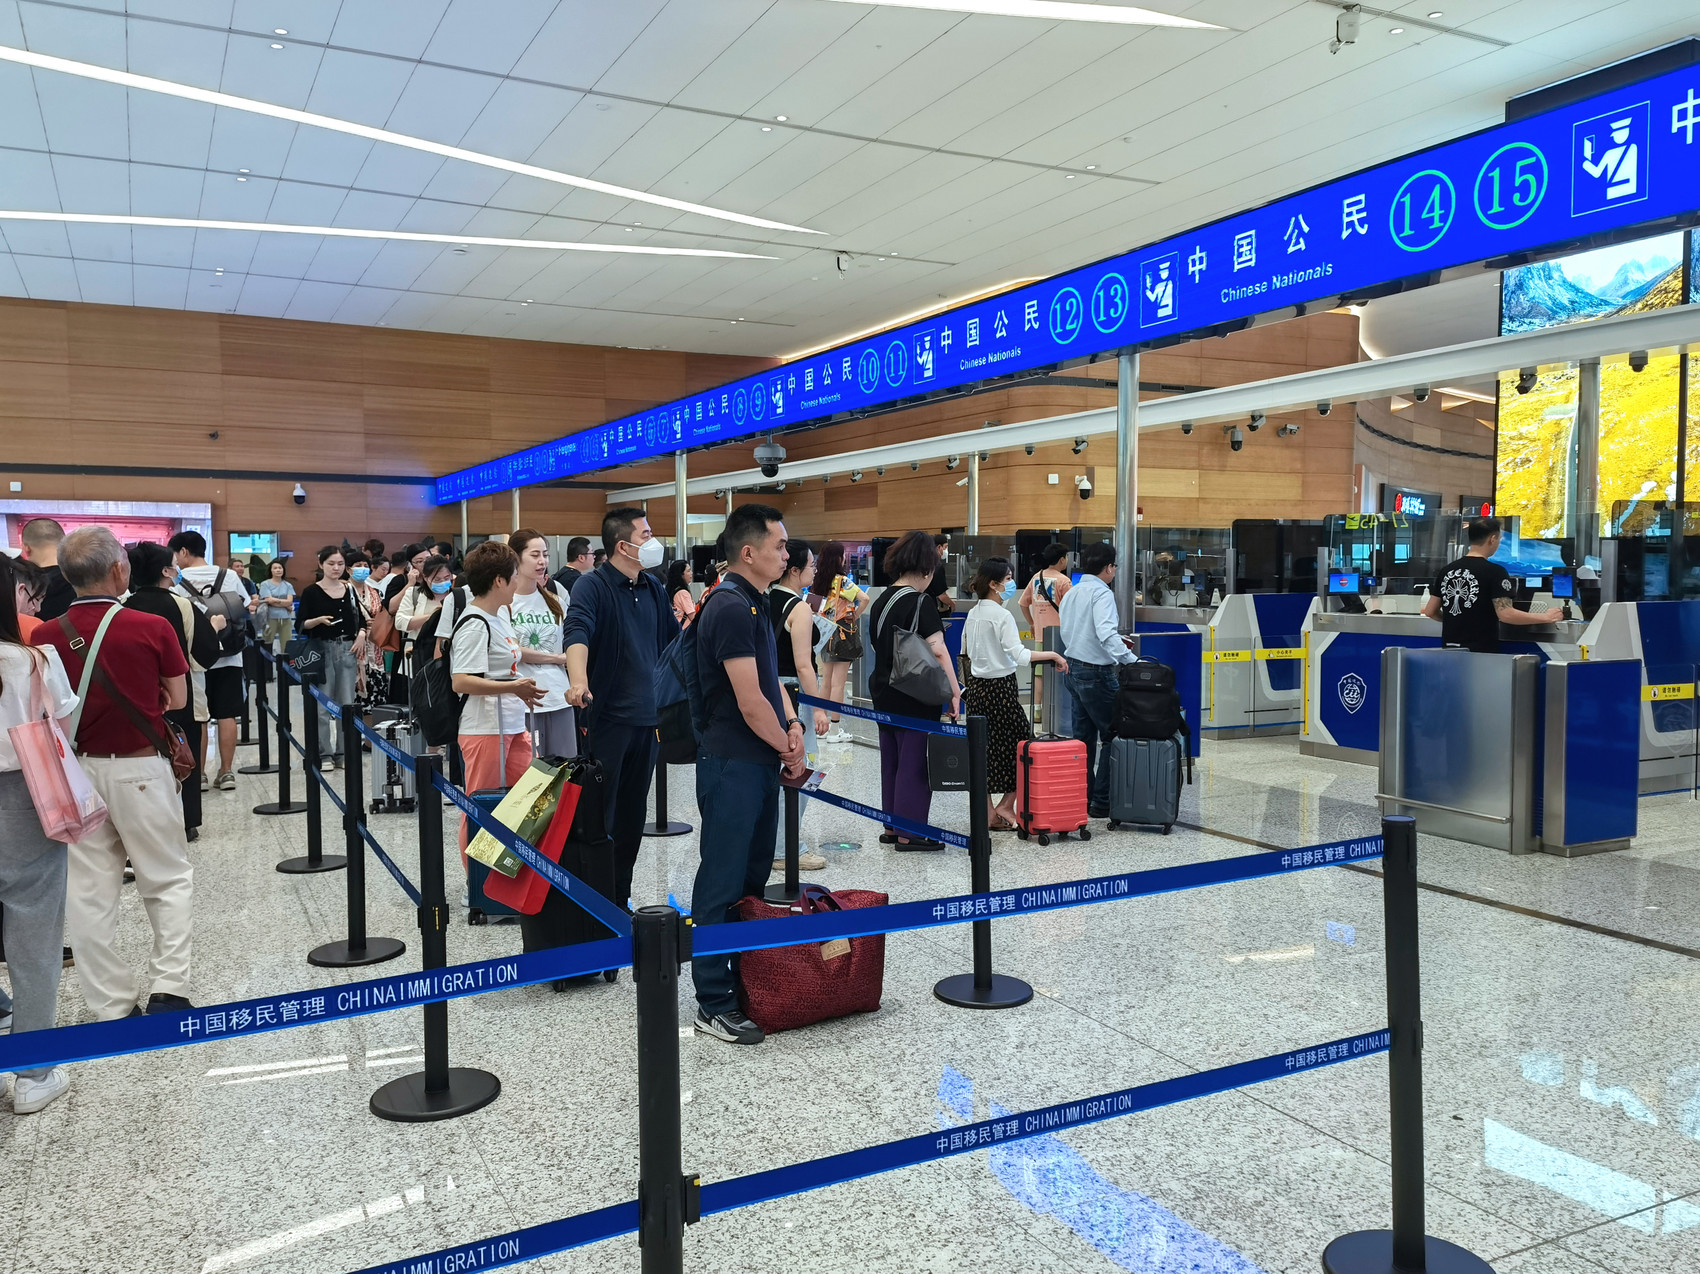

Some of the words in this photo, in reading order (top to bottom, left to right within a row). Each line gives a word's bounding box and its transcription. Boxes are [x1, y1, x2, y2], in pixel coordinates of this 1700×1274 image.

[1187, 193, 1369, 284] 中国公民
[1398, 183, 1446, 238] 14
[1486, 155, 1538, 215] 15
[1220, 280, 1268, 304] Chinese
[1271, 261, 1333, 291] Nationals
[940, 299, 1040, 355] 中国公民
[1054, 297, 1078, 334] 12
[1097, 283, 1123, 322] 13
[959, 353, 987, 371] Chinese
[988, 345, 1022, 364] Nationals
[787, 356, 853, 396] 中国公民
[800, 397, 819, 410] Chinese
[819, 392, 841, 406] Nationals
[1281, 846, 1346, 869] 中国移民管理
[932, 894, 1016, 921] 中国移民管理
[180, 996, 326, 1038] 中国移民管理
[337, 963, 518, 1012] CHINAIMMIGRATION
[1285, 1043, 1349, 1070] 中国移民管理
[936, 1119, 1019, 1153] 中国移民管理
